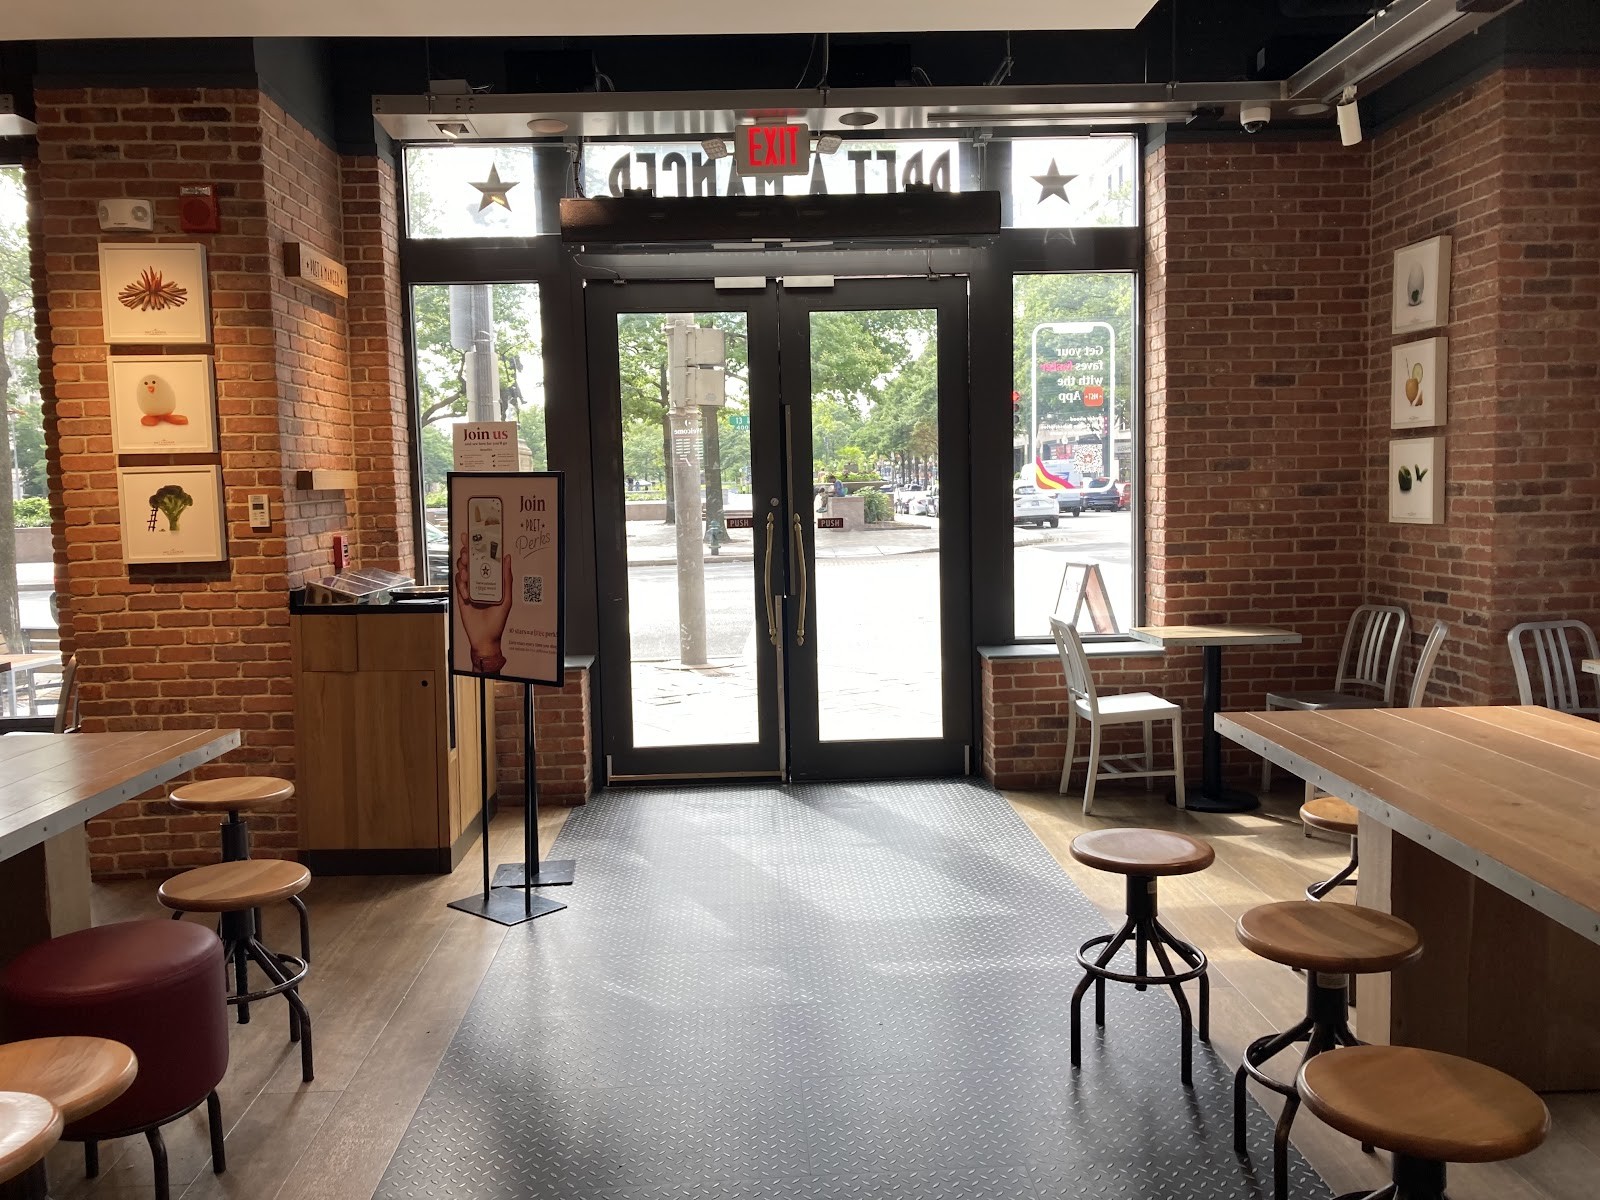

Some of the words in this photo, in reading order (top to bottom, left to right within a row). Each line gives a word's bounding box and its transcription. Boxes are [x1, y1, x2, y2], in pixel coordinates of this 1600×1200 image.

[748, 126, 799, 166] EXIT
[463, 426, 490, 442] Join
[492, 430, 508, 440] us
[519, 494, 546, 513] Join
[525, 518, 541, 532] PRET
[729, 518, 749, 527] PUSH
[821, 518, 840, 527] PUSH
[515, 530, 551, 555] Perks
